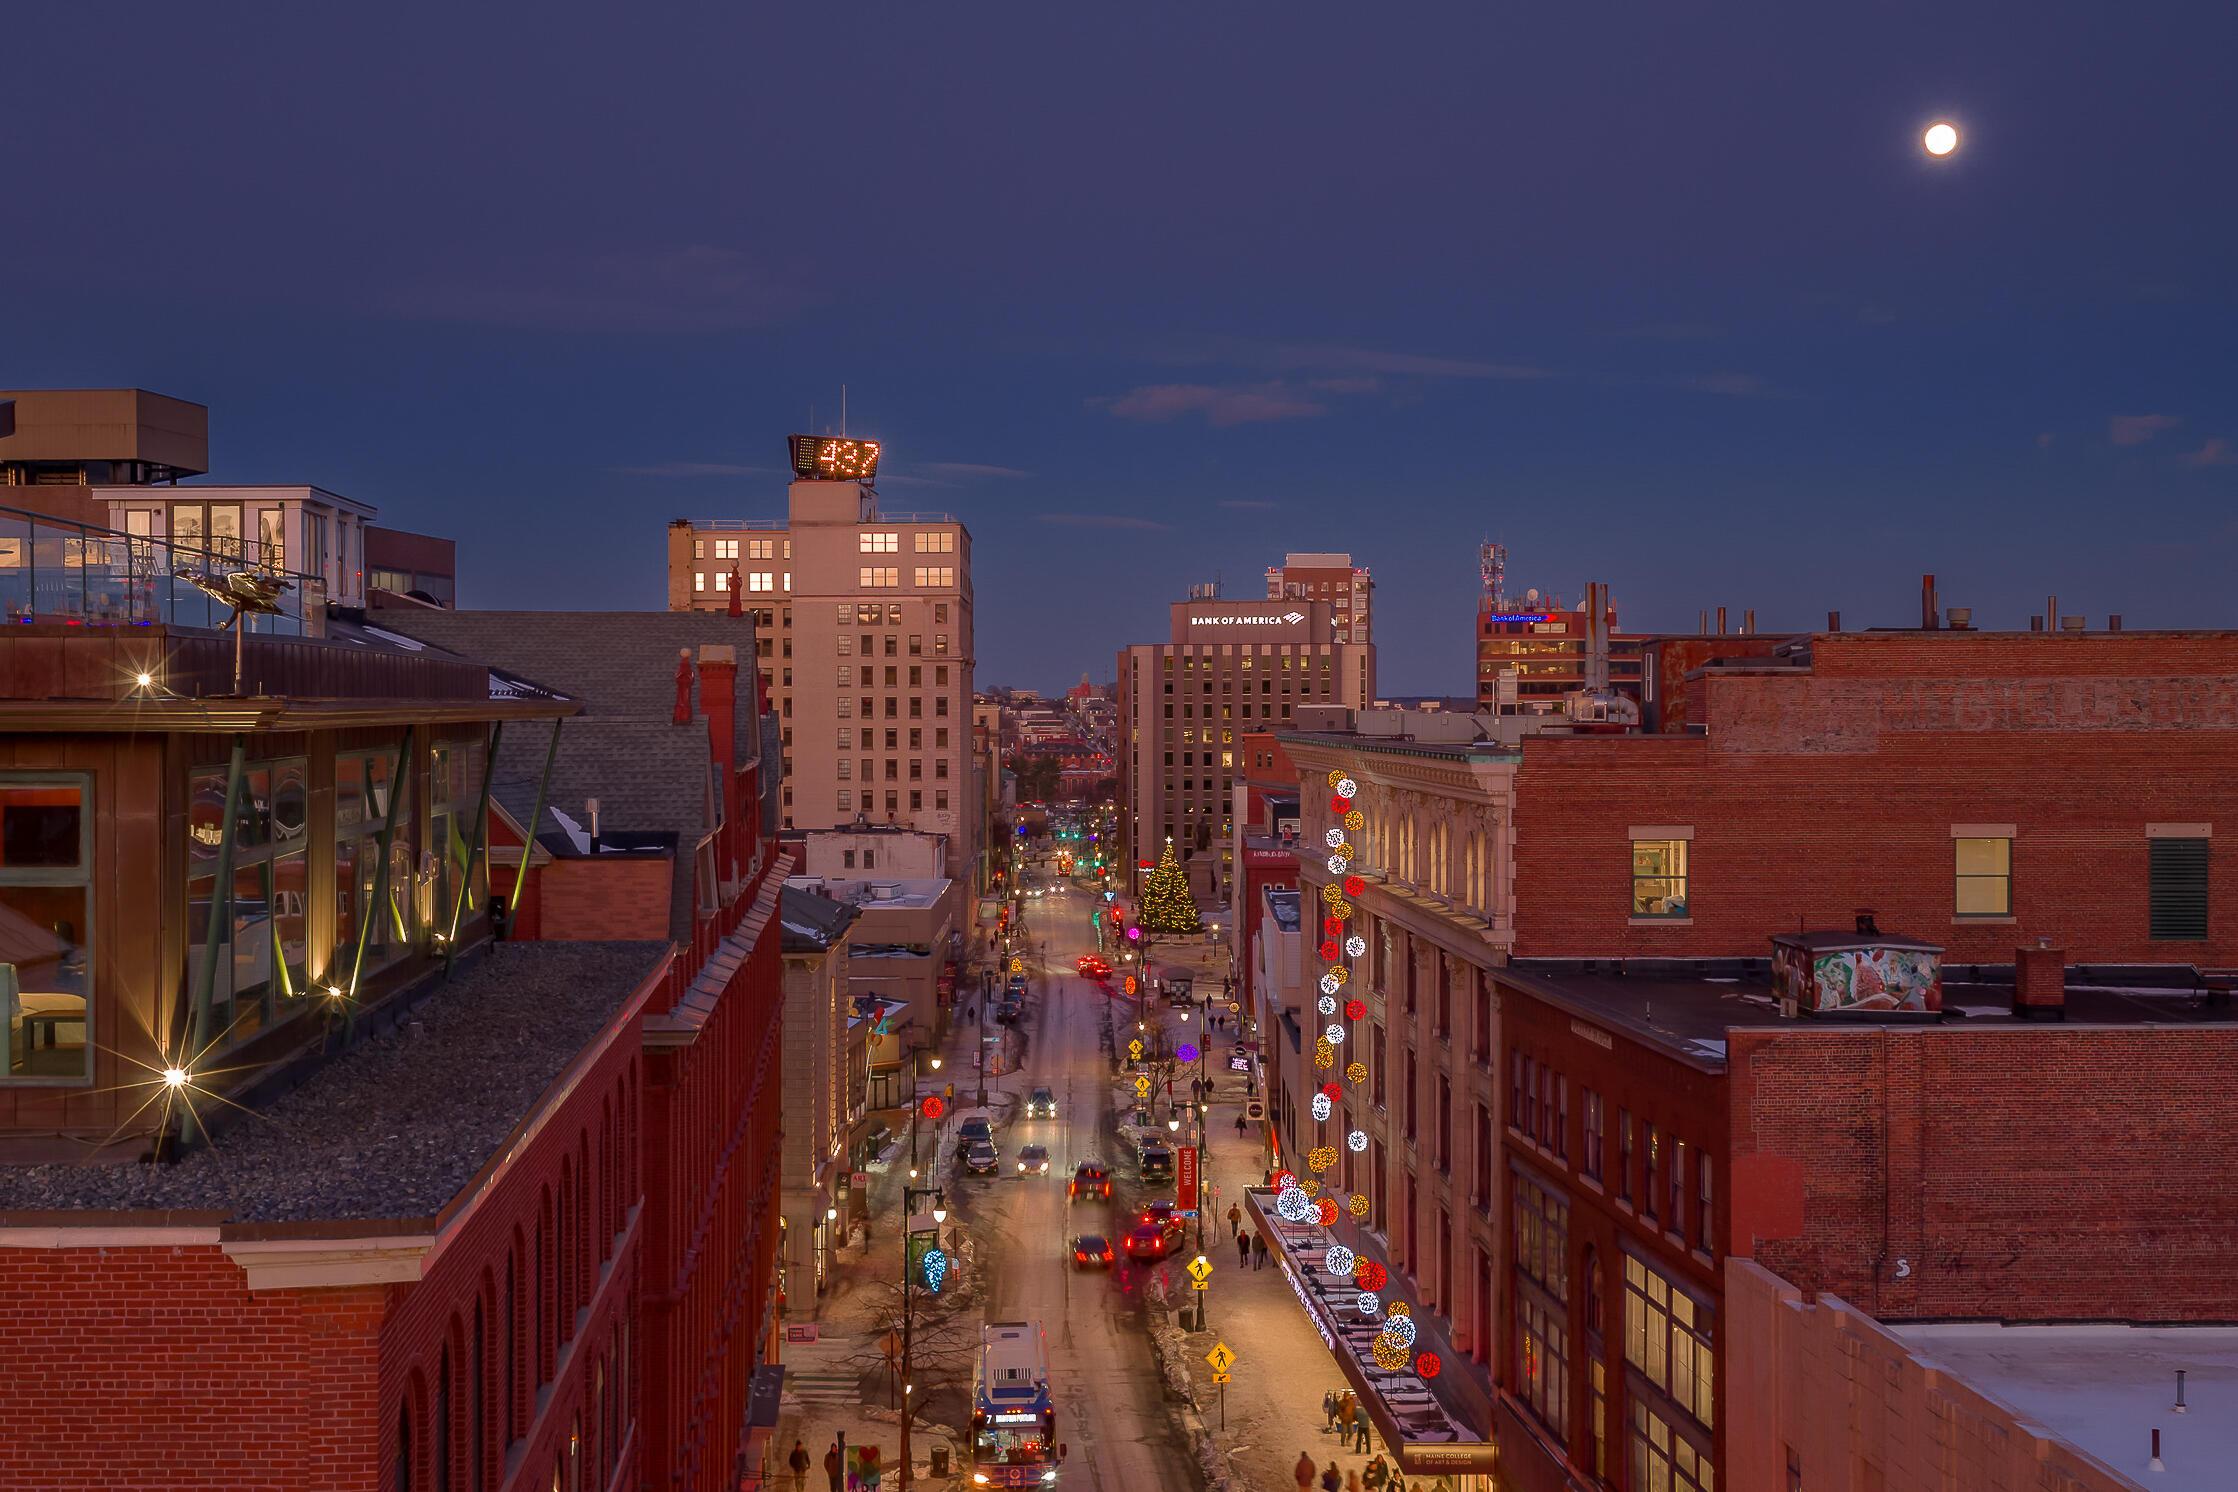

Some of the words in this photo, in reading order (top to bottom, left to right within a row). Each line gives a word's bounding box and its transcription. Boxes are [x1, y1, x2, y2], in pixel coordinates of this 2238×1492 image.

[1192, 617, 1219, 625] BANK
[1221, 616, 1234, 625] OF
[1236, 616, 1282, 625] AMERICA
[1184, 1149, 1192, 1186] WELCOME
[986, 1415, 992, 1424] 7
